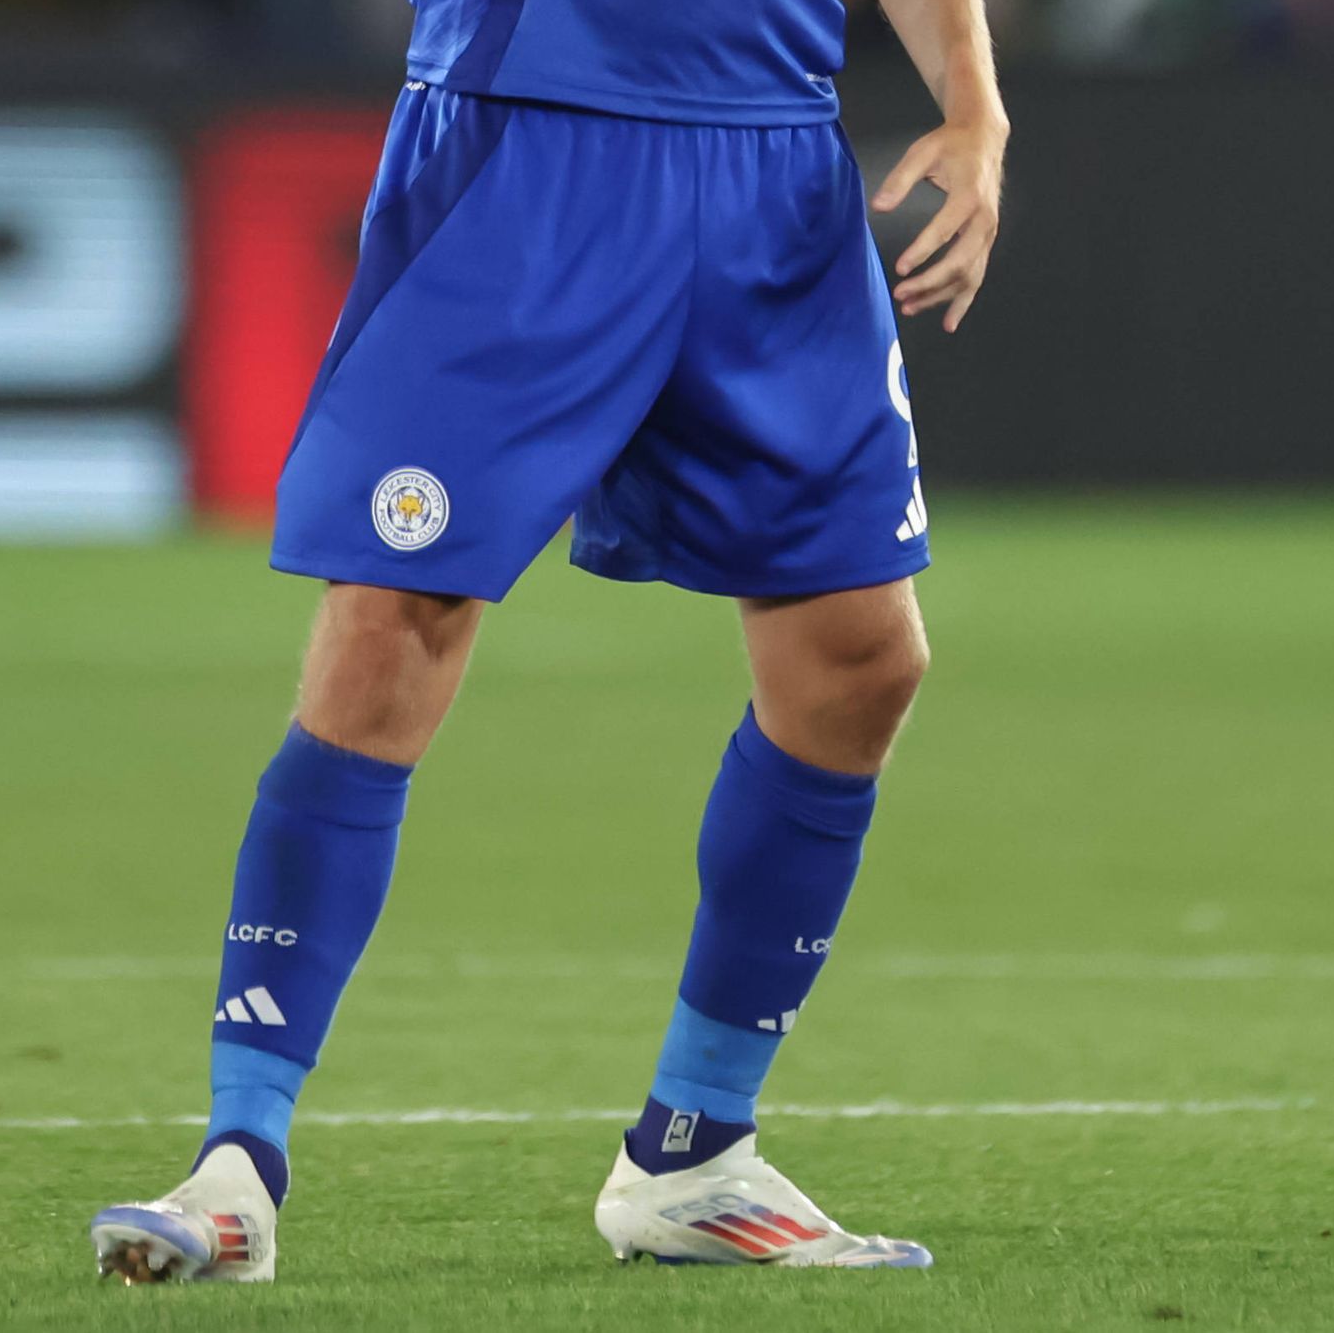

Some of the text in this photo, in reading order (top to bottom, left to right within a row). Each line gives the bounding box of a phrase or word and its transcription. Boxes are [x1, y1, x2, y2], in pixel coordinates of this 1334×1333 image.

[380, 475, 442, 512] LEICESTER CITY
[378, 509, 441, 543] FOOTBALL CLUB
[227, 922, 299, 948] LCFC
